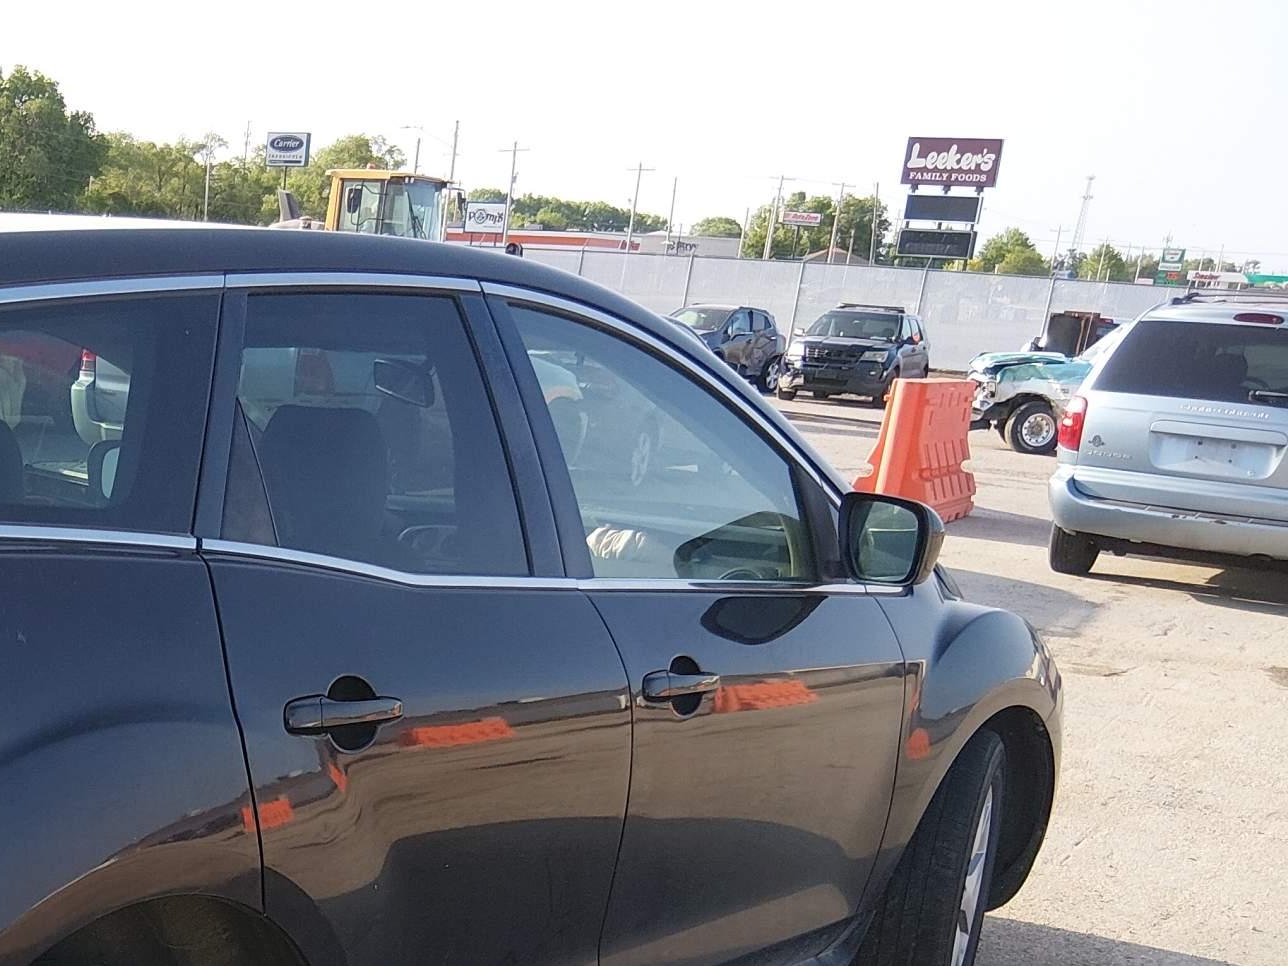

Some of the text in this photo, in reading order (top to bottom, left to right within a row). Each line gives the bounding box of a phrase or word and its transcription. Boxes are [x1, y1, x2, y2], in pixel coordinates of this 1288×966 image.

[906, 142, 996, 171] Leeker's
[909, 171, 987, 182] FAMILY FOODS
